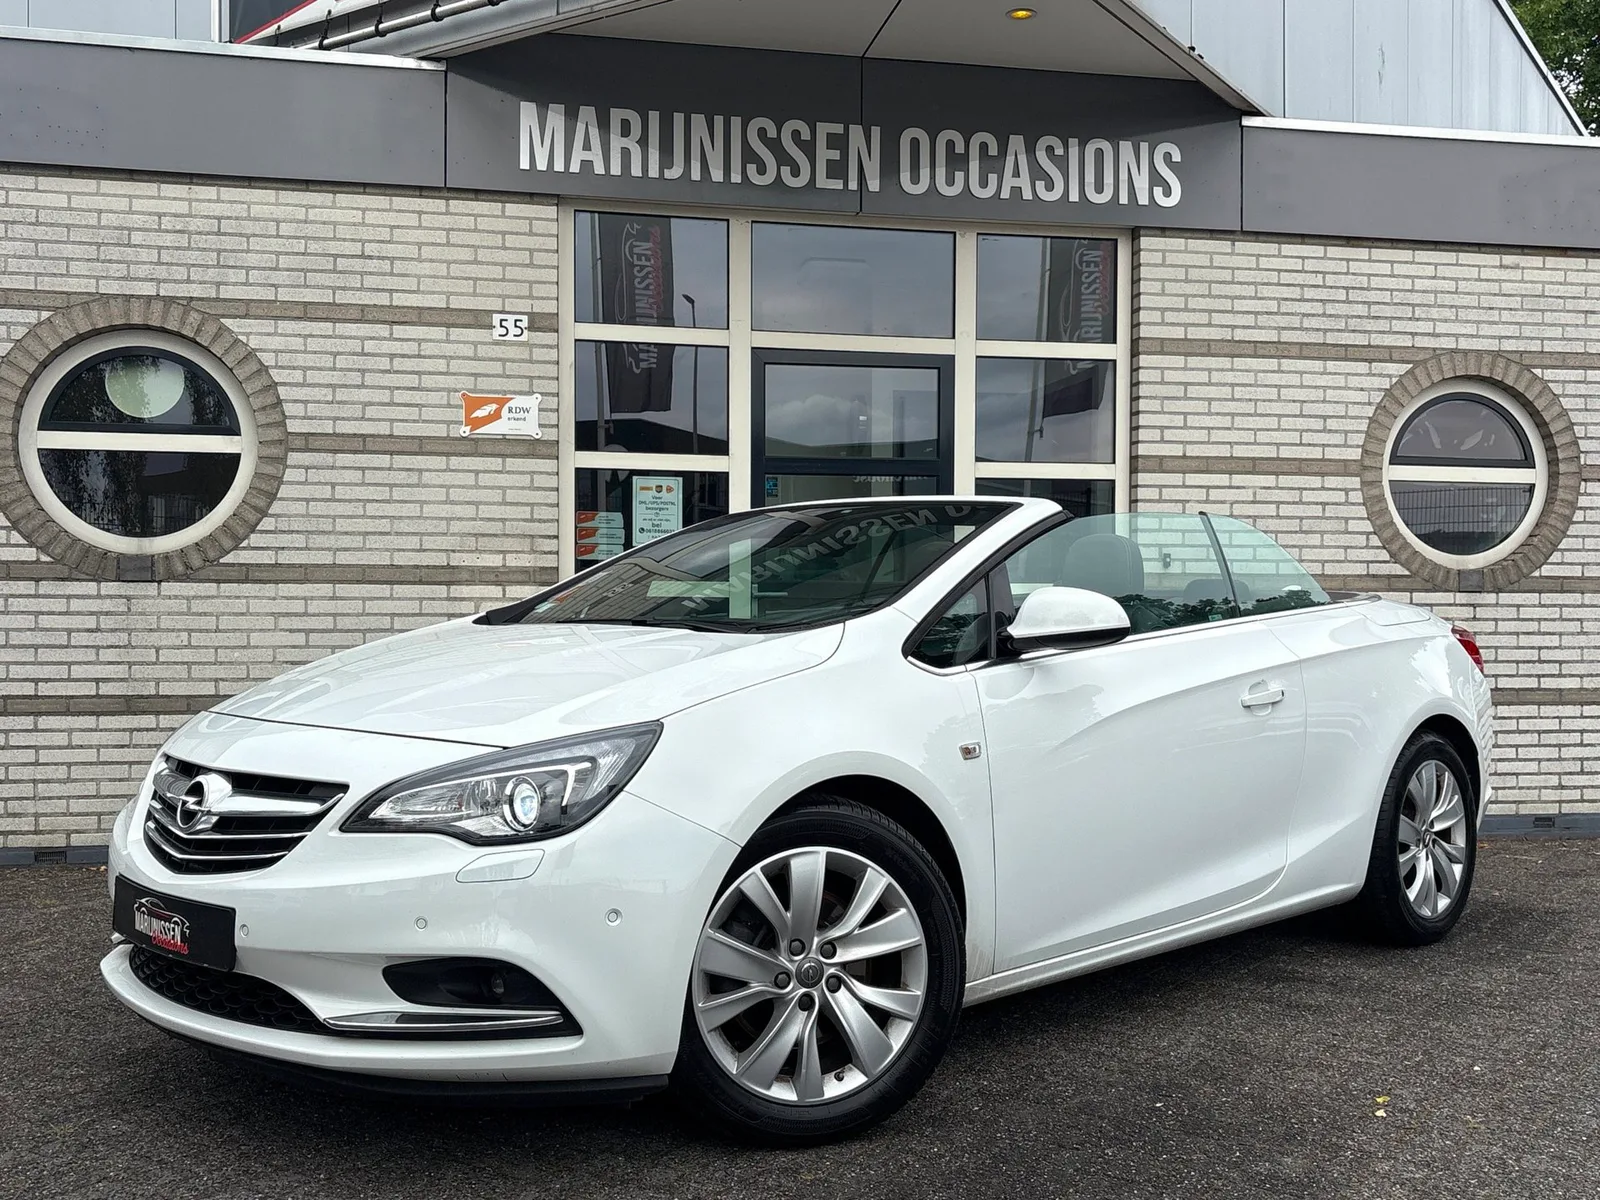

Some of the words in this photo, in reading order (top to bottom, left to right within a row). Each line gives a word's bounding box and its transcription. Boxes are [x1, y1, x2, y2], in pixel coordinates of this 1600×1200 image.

[518, 101, 881, 193] MARIJNISSEN
[899, 127, 1183, 208] OCCASIONS
[498, 319, 525, 338] 55
[507, 406, 532, 415] RDW
[134, 910, 182, 945] MARIJNISSEN
